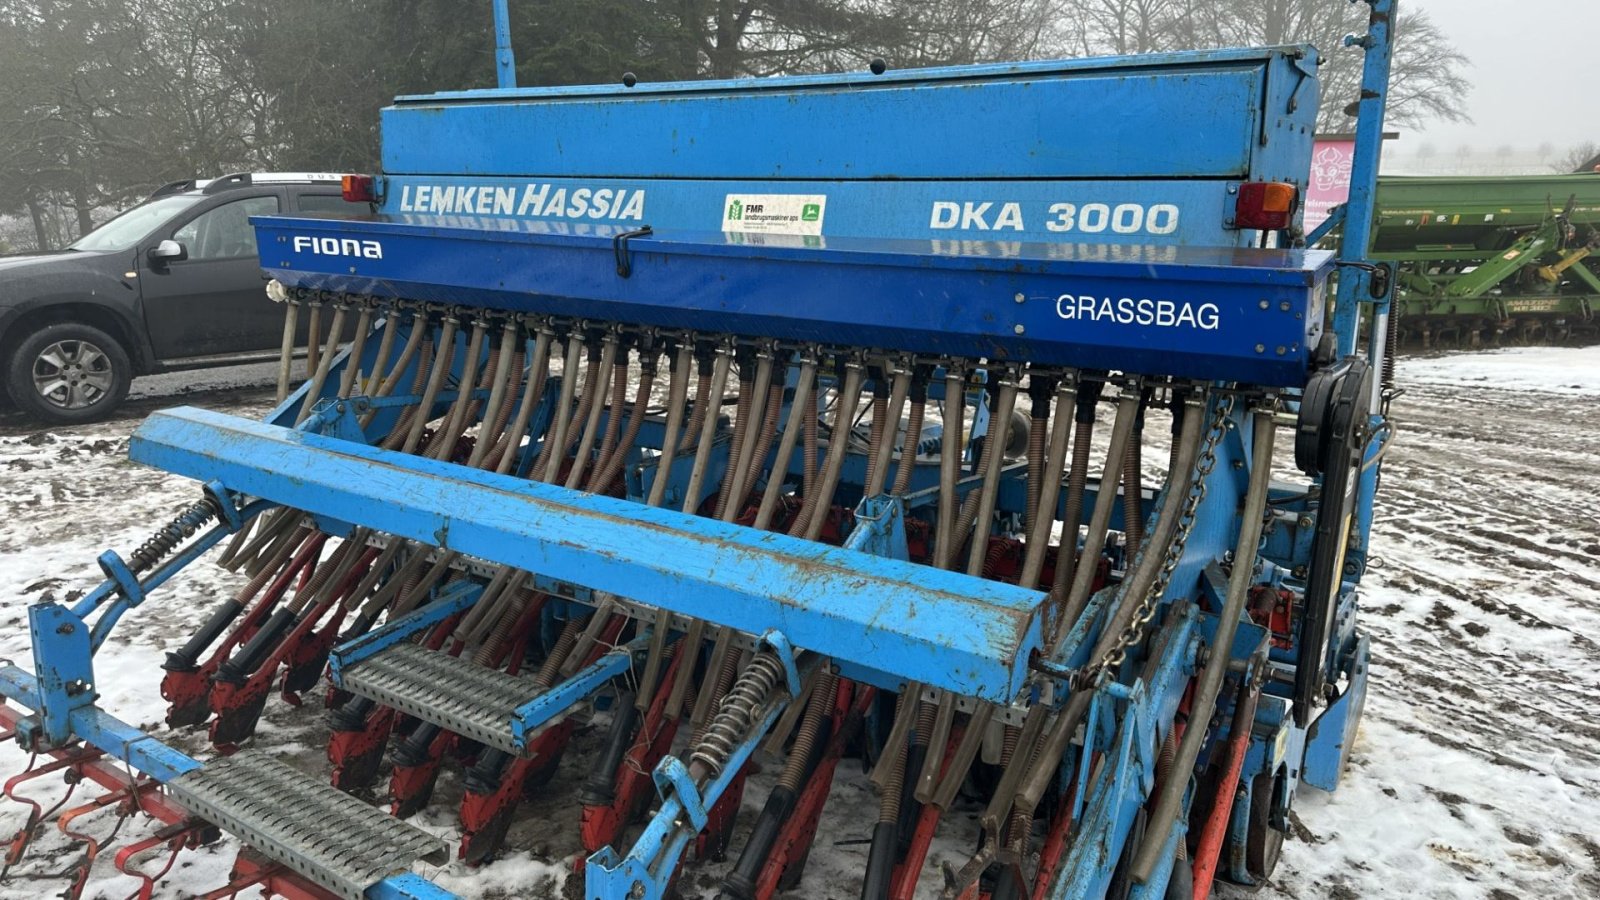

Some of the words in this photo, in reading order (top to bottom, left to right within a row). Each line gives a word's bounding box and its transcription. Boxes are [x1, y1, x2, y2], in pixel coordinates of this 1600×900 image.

[400, 186, 516, 215] LEMKEN
[517, 184, 645, 220] HASSIA
[745, 204, 764, 213] FMR
[930, 201, 1024, 231] DKA
[1046, 203, 1179, 234] 3000
[1056, 294, 1219, 330] GRASSBAG
